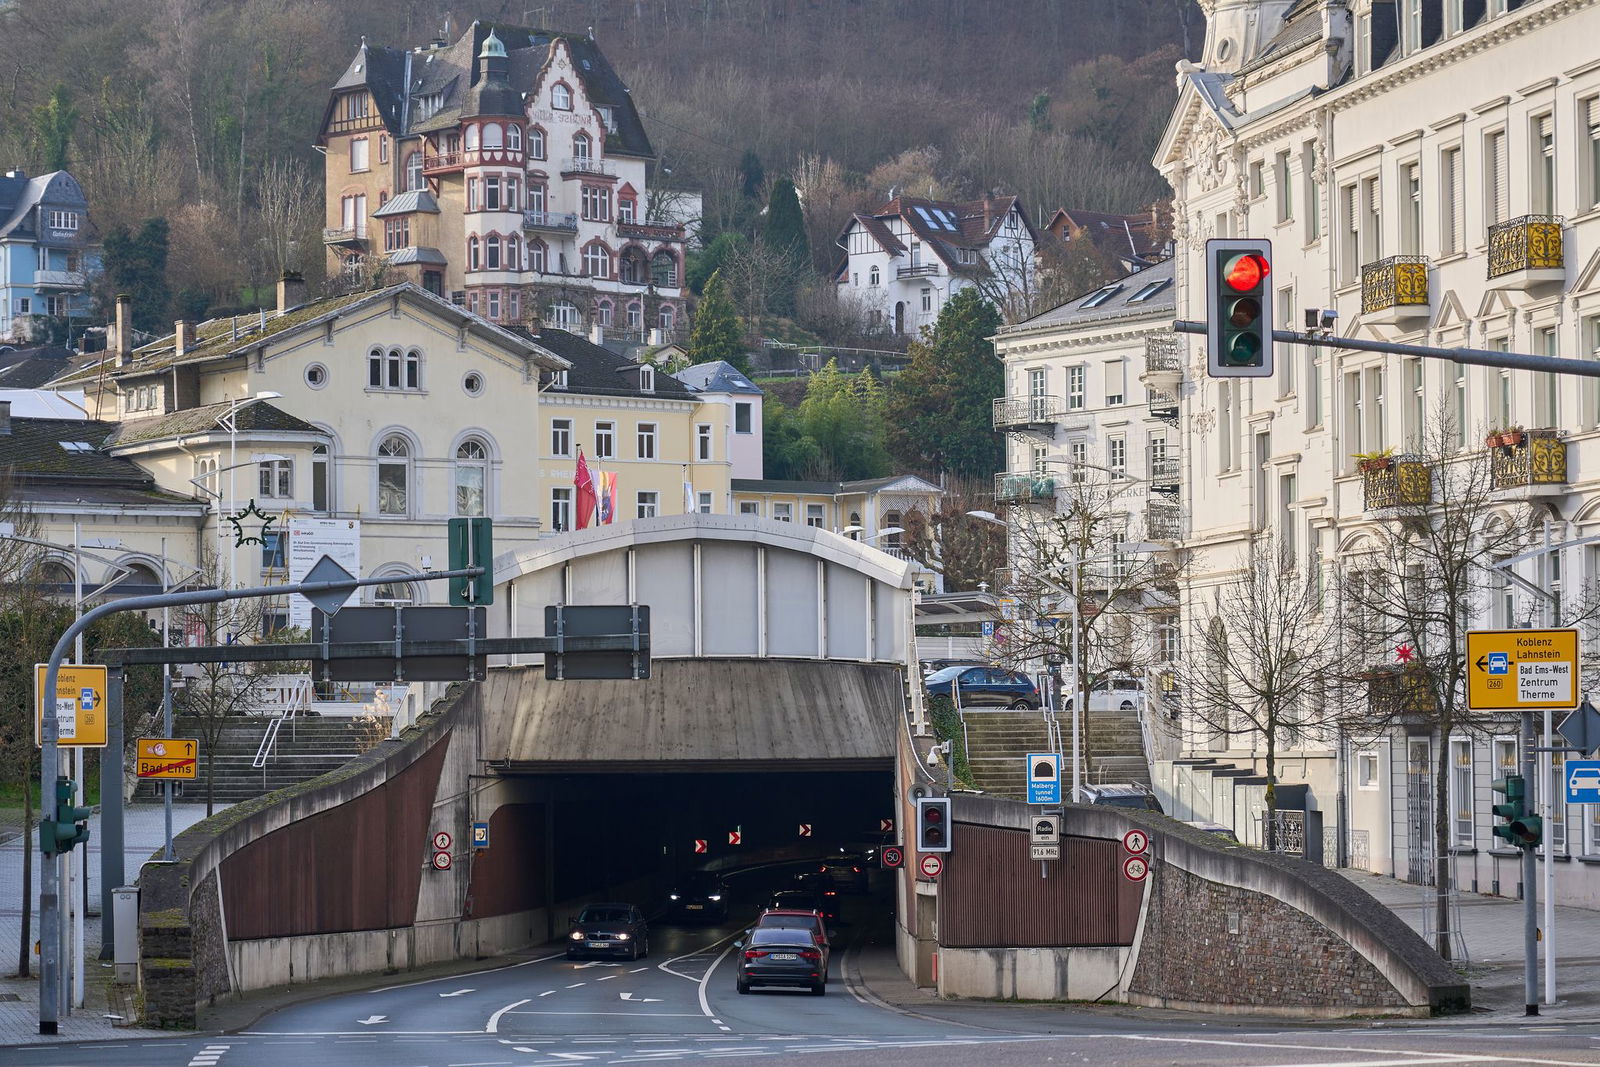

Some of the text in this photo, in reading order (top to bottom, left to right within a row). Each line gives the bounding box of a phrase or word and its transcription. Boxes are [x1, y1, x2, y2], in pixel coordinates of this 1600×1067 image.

[1517, 638, 1552, 647] Koblenz
[1517, 650, 1561, 659] Lahnstein
[1520, 665, 1569, 675] Bad Ems-West
[57, 673, 76, 683] oblenz
[1520, 678, 1558, 687] Zentrum
[1489, 680, 1501, 688] 260
[1520, 690, 1555, 699] Therme
[57, 715, 74, 723] ntrum
[141, 762, 192, 774] Bad Ems
[1045, 848, 1057, 856] MHz
[886, 852, 899, 862] 50
